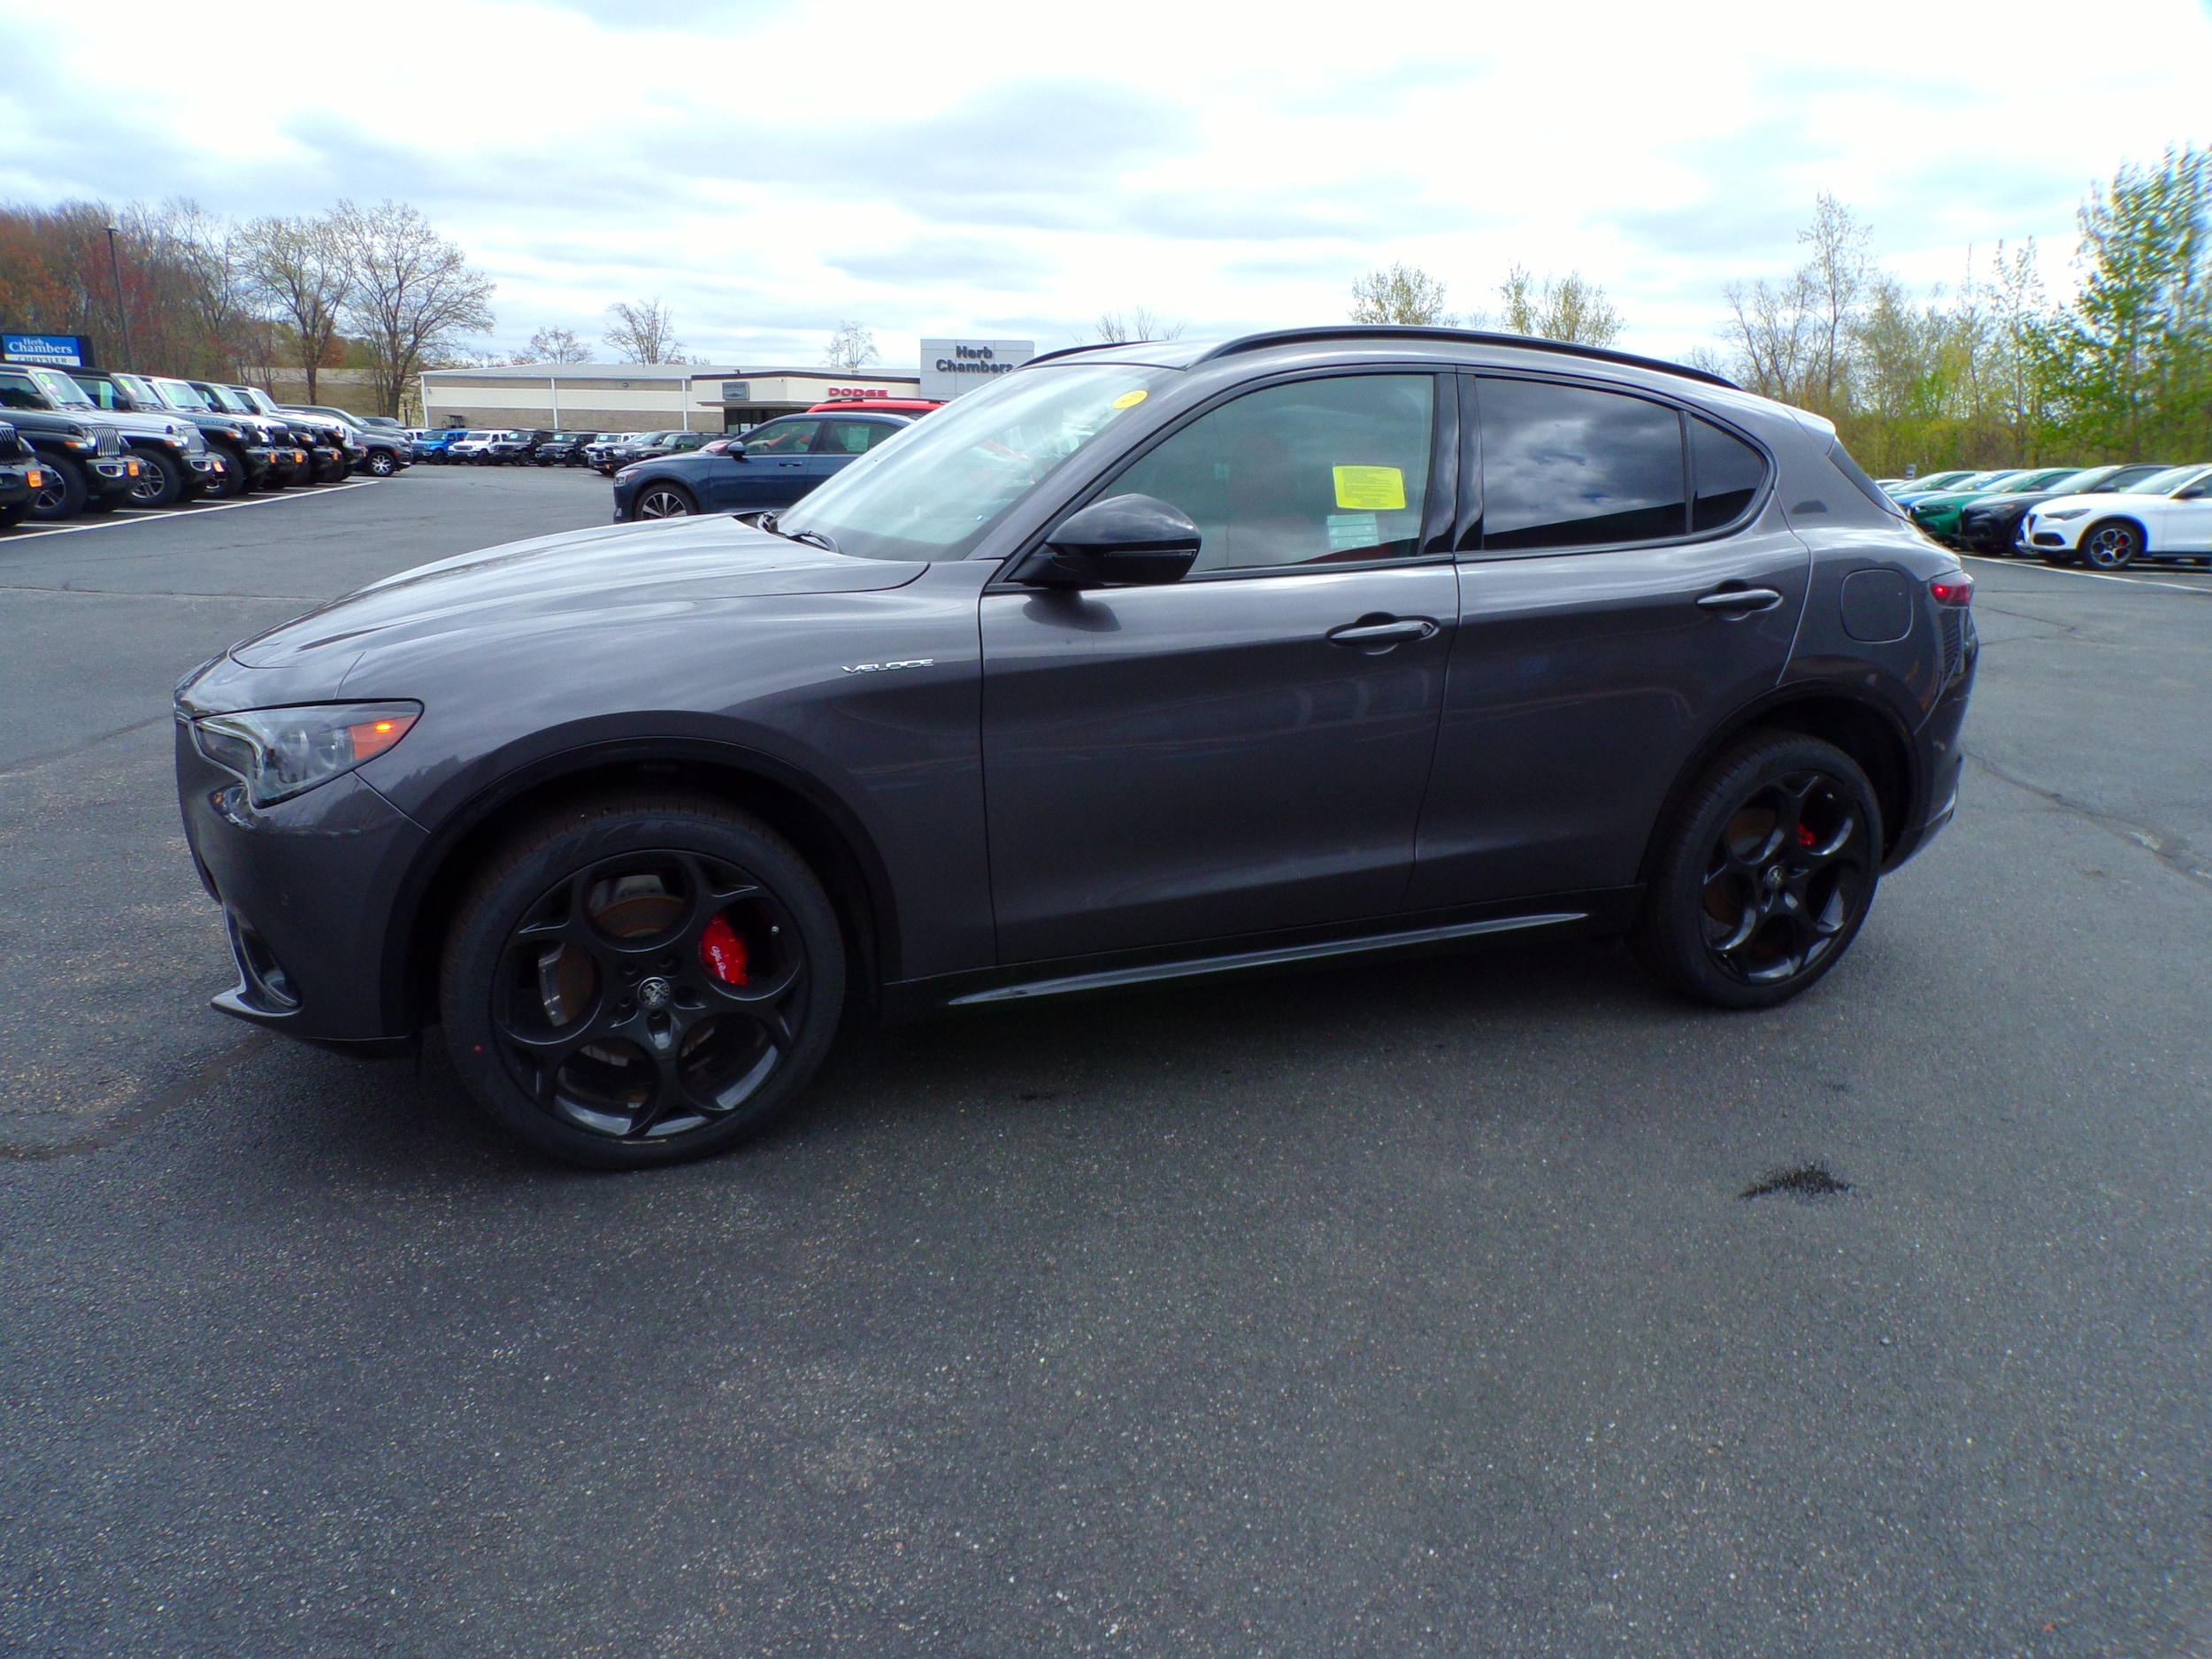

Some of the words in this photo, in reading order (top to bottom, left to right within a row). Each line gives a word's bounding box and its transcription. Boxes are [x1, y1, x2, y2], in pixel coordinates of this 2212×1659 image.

[8, 342, 73, 354] Chambers
[956, 345, 993, 359] Herb
[936, 358, 1014, 373] Chambers
[828, 387, 888, 397] DODGE
[841, 658, 934, 673] VELOCE
